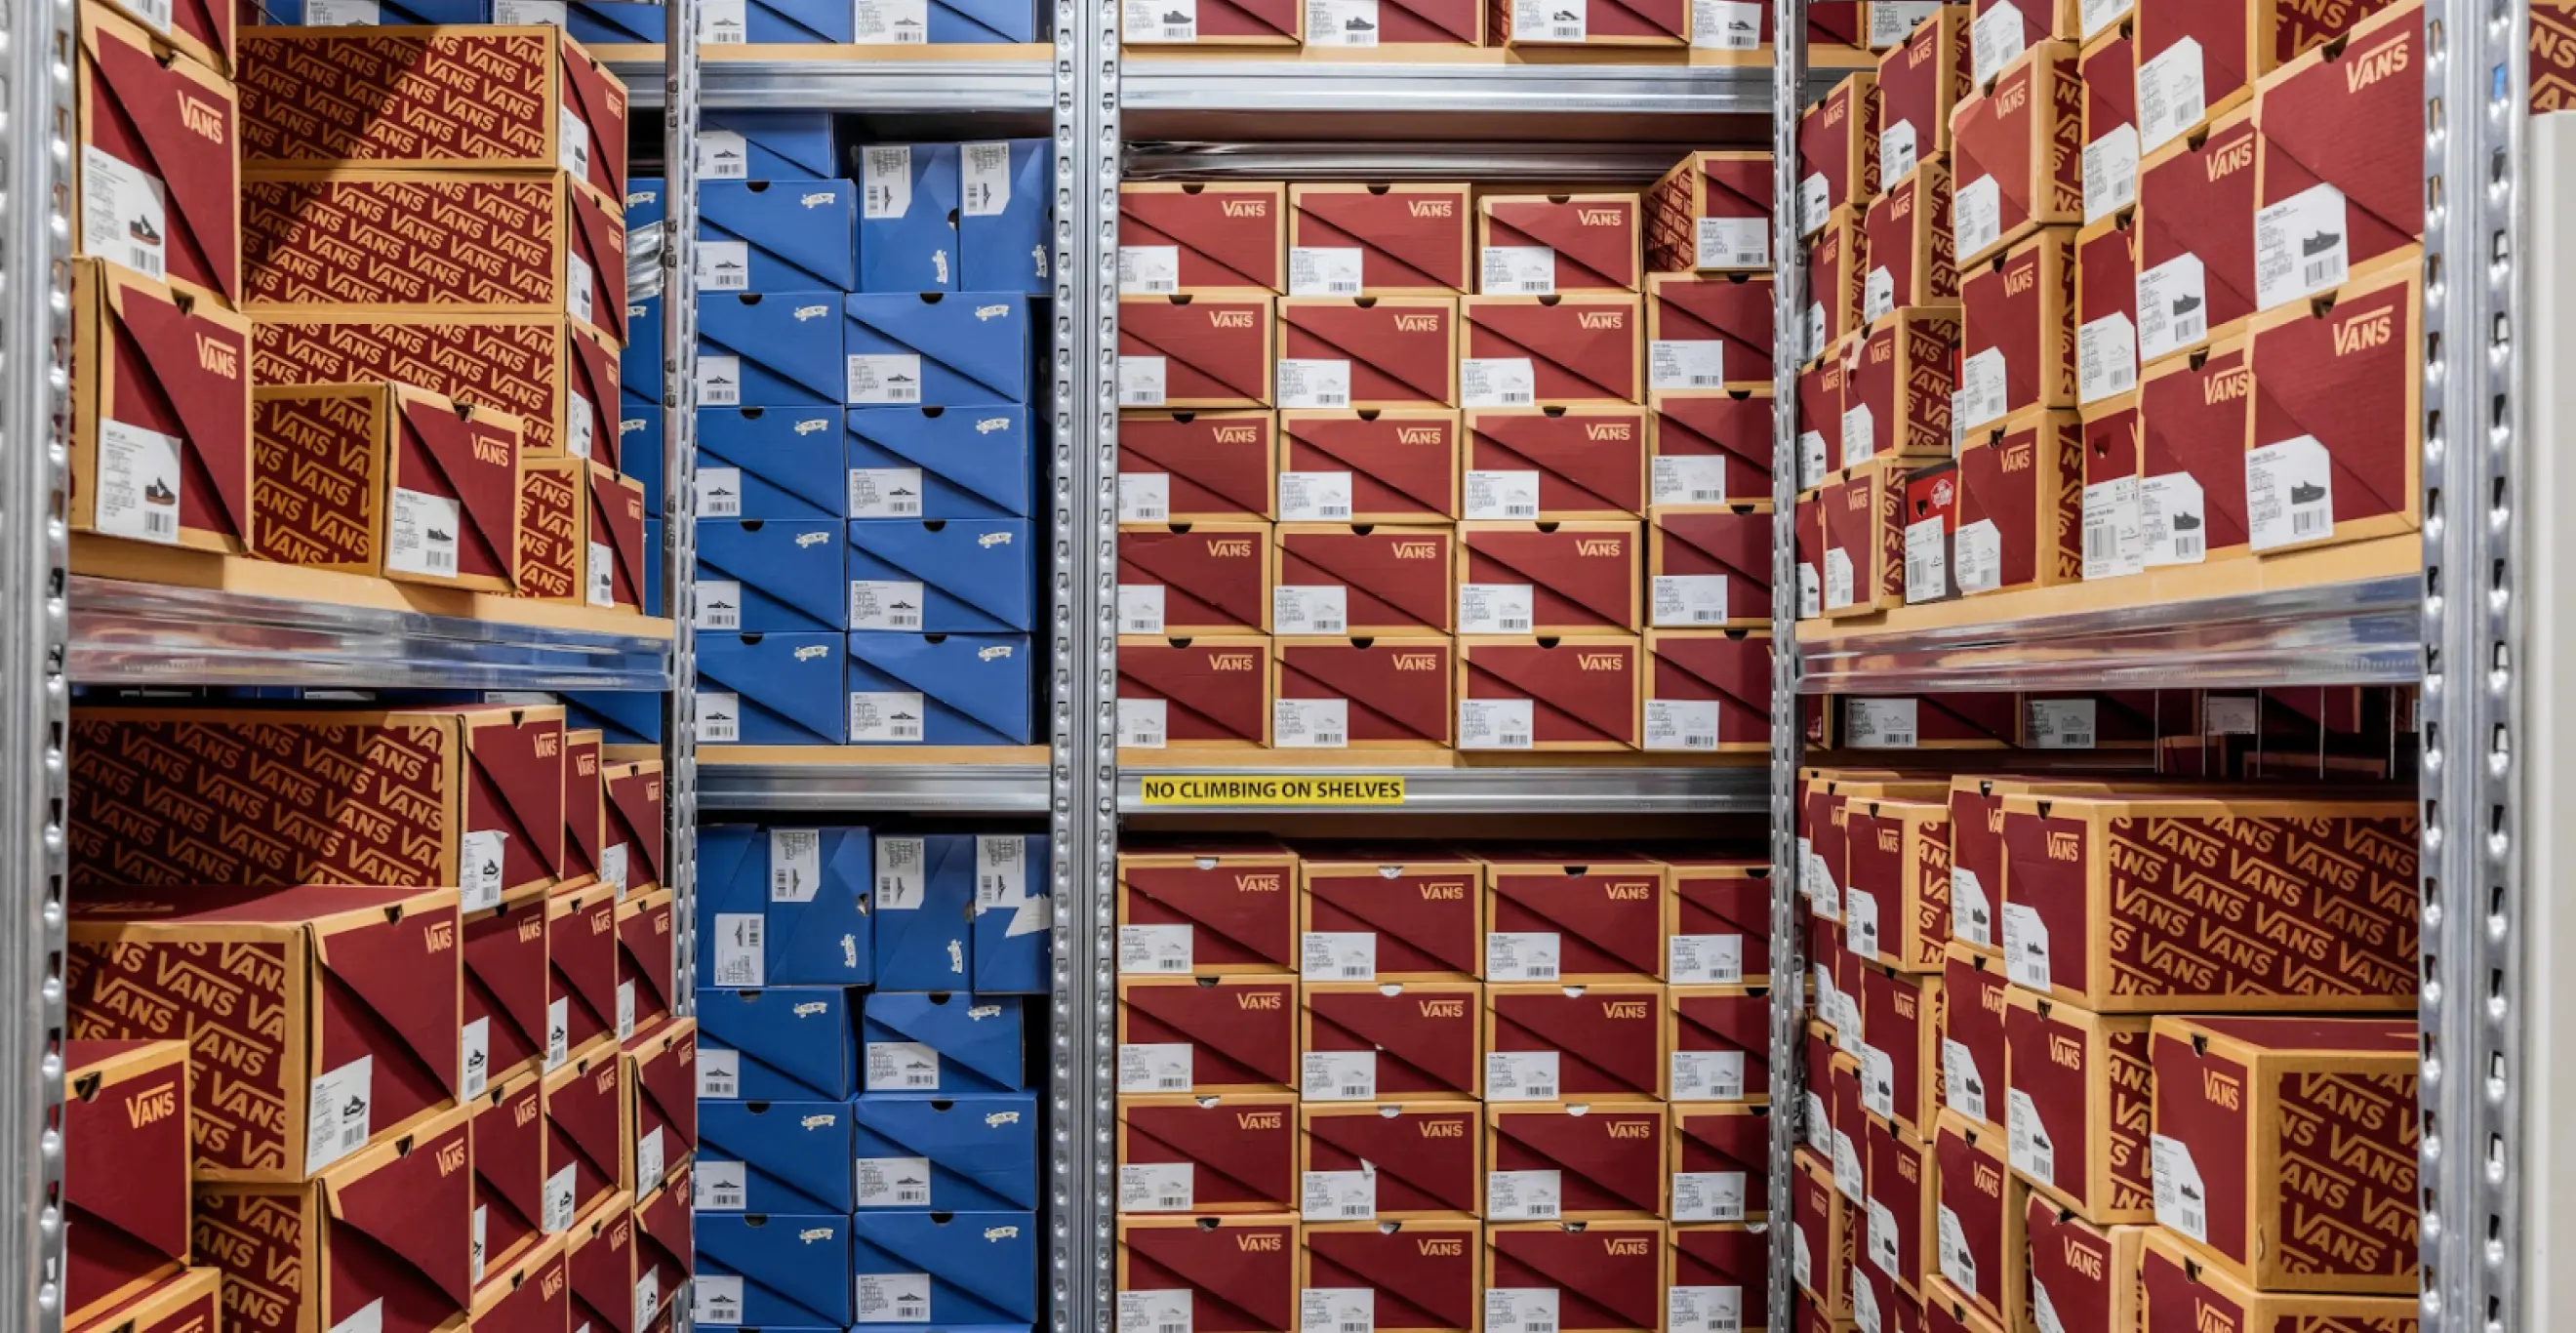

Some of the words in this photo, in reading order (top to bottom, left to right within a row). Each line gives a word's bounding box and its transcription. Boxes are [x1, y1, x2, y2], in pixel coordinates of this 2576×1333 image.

[287, 48, 341, 88] VANS
[327, 37, 382, 78] VANS
[424, 52, 480, 93] VANS
[466, 42, 521, 83] VANS
[1909, 36, 1932, 69] VANS
[2346, 31, 2410, 93] VANS
[247, 59, 302, 98] VANS
[344, 74, 399, 114] VANS
[385, 62, 441, 104] VANS
[178, 90, 222, 143] VANS
[264, 96, 319, 137] VANS
[305, 86, 358, 126] VANS
[444, 90, 499, 132] VANS
[486, 79, 539, 121] VANS
[1995, 80, 2025, 119] VANS
[363, 112, 419, 153] VANS
[402, 101, 458, 141] VANS
[2206, 133, 2252, 182] VANS
[250, 202, 305, 243] VANS
[292, 191, 346, 232] VANS
[333, 182, 388, 222] VANS
[433, 198, 488, 239] VANS
[473, 187, 530, 229] VANS
[1222, 201, 1266, 216] VANS
[1408, 201, 1452, 217] VANS
[1578, 210, 1621, 225] VANS
[309, 230, 365, 270] VANS
[350, 219, 406, 260] VANS
[391, 209, 448, 250] VANS
[493, 225, 546, 266] VANS
[268, 240, 323, 281] VANS
[410, 246, 465, 287] VANS
[451, 236, 507, 277] VANS
[369, 257, 425, 298] VANS
[2004, 263, 2033, 297] VANS
[1210, 311, 1253, 327] VANS
[1394, 315, 1438, 331] VANS
[1579, 312, 1623, 328] VANS
[2333, 305, 2393, 356] VANS
[196, 333, 236, 379] VANS
[287, 333, 343, 374] VANS
[330, 324, 386, 365] VANS
[431, 341, 487, 383] VANS
[474, 330, 530, 372] VANS
[390, 350, 446, 392] VANS
[491, 368, 547, 410] VANS
[2204, 365, 2248, 404] VANS
[270, 403, 336, 457] VANS
[472, 433, 508, 466] VANS
[1213, 426, 1257, 442] VANS
[1397, 428, 1441, 444] VANS
[1586, 424, 1630, 440] VANS
[2000, 443, 2030, 472] VANS
[292, 453, 356, 505] VANS
[312, 503, 370, 556] VANS
[1208, 541, 1251, 556] VANS
[1576, 540, 1620, 556] VANS
[1392, 543, 1435, 558] VANS
[1209, 655, 1253, 669] VANS
[1393, 655, 1436, 669] VANS
[1578, 655, 1623, 669] VANS
[122, 728, 191, 781] VANS
[356, 726, 426, 781] VANS
[534, 733, 557, 757] VANS
[249, 752, 321, 807] VANS
[302, 739, 375, 794] VANS
[143, 778, 215, 832] VANS
[196, 765, 268, 820] VANS
[379, 776, 442, 831] VANS
[1147, 783, 1174, 797] NO
[1181, 783, 1275, 797] CLIMBING
[1282, 783, 1310, 797] ON
[1317, 782, 1400, 797] SHELVES
[91, 792, 163, 846] VANS
[273, 802, 344, 857] VANS
[325, 789, 397, 844] VANS
[168, 828, 238, 883] VANS
[219, 815, 291, 870] VANS
[1877, 828, 1899, 852] VANS
[2047, 831, 2078, 862] VANS
[2147, 818, 2226, 868] VANS
[2343, 819, 2419, 876] VANS
[2231, 849, 2309, 907] VANS
[2286, 832, 2365, 891] VANS
[1235, 874, 1279, 891] VANS
[1420, 883, 1464, 899] VANS
[1605, 884, 1649, 899] VANS
[2172, 863, 2250, 921] VANS
[2116, 878, 2194, 937] VANS
[2314, 887, 2392, 946] VANS
[424, 921, 452, 952] VANS
[518, 914, 542, 943] VANS
[2198, 917, 2277, 976] VANS
[2256, 902, 2334, 960] VANS
[2141, 933, 2220, 991] VANS
[94, 967, 180, 1033] VANS
[156, 950, 243, 1017] VANS
[1237, 992, 1280, 1009] VANS
[1420, 1000, 1463, 1017] VANS
[1603, 1002, 1647, 1018] VANS
[1894, 990, 1914, 1019] VANS
[2050, 1033, 2080, 1070] VANS
[126, 1082, 175, 1128] VANS
[2204, 1068, 2239, 1111] VANS
[2300, 1072, 2393, 1130] VANS
[1237, 1112, 1281, 1129] VANS
[1420, 1121, 1463, 1137] VANS
[1606, 1121, 1650, 1138] VANS
[436, 1138, 463, 1177] VANS
[1897, 1151, 1916, 1183] VANS
[2330, 1123, 2418, 1192] VANS
[1974, 1161, 1999, 1197] VANS
[1237, 1234, 1281, 1251] VANS
[1418, 1239, 1462, 1255] VANS
[1604, 1239, 1648, 1255] VANS
[2294, 1202, 2387, 1272] VANS
[2065, 1236, 2102, 1280] VANS
